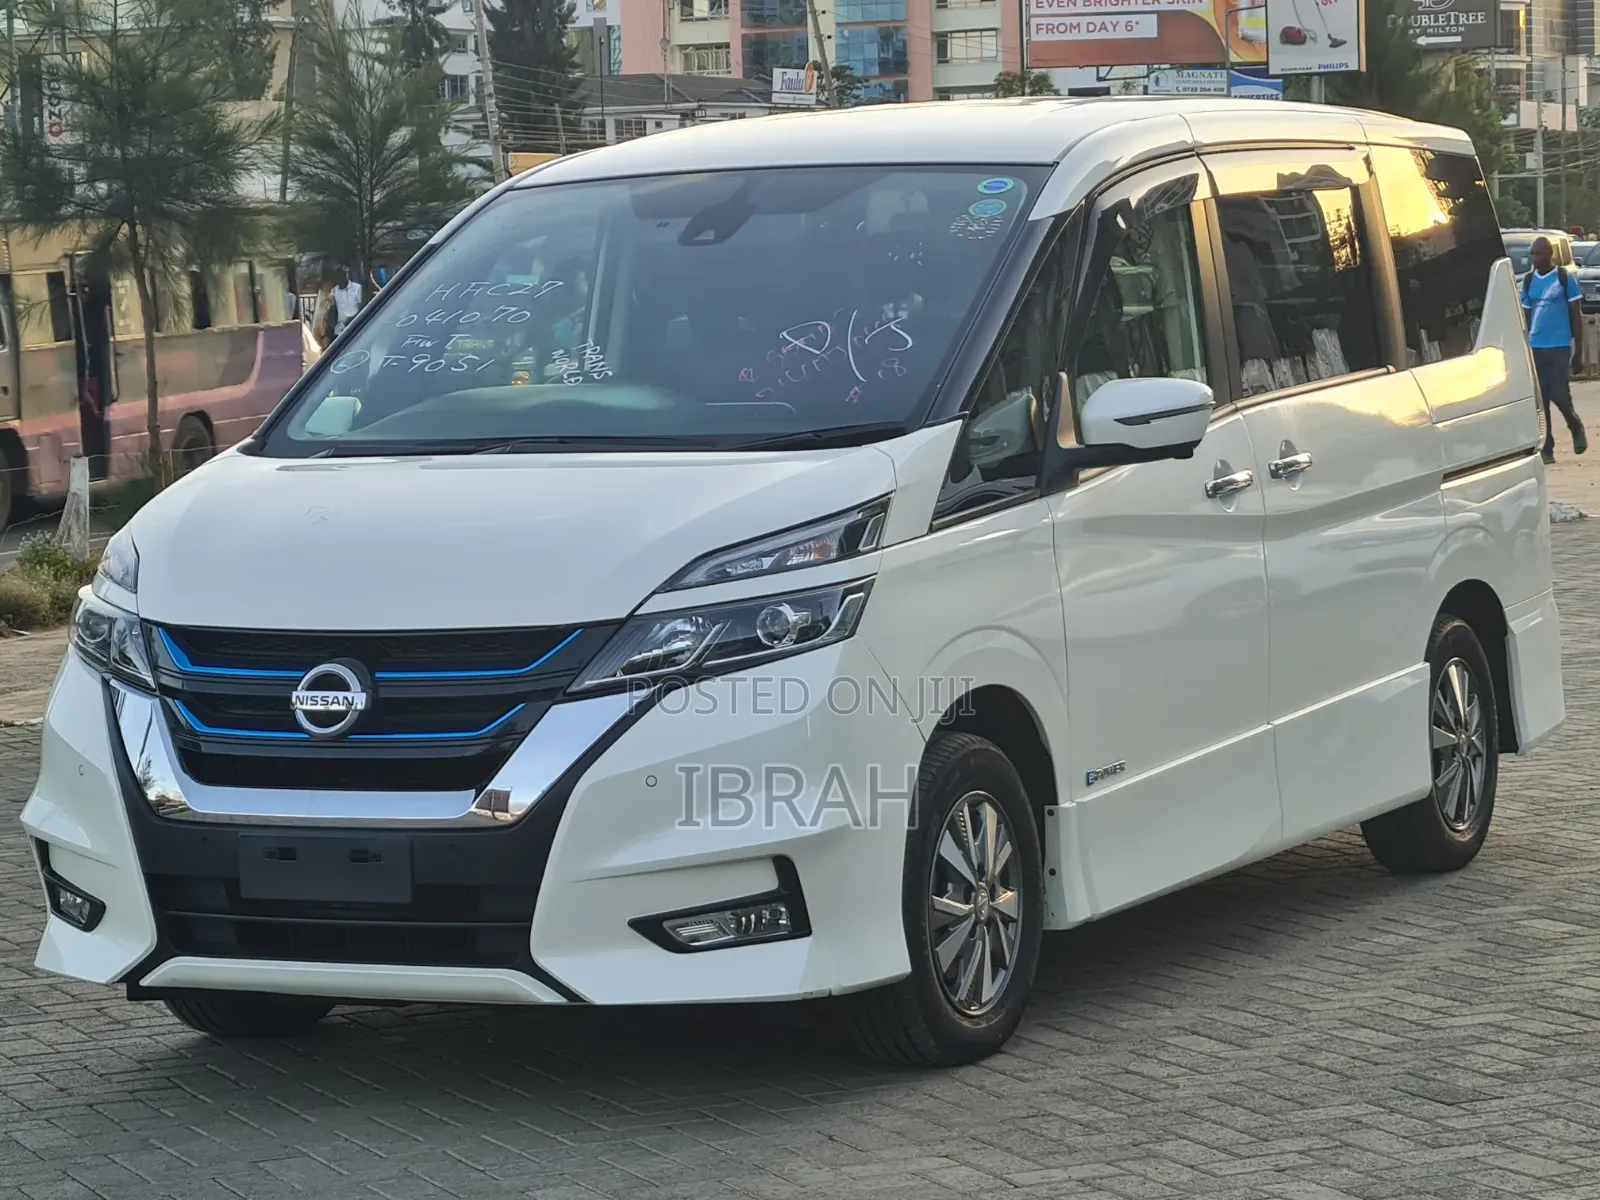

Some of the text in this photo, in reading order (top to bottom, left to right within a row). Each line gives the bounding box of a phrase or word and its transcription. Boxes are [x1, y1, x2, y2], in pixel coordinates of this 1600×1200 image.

[1036, 22, 1081, 35] FROM
[1086, 21, 1119, 33] DAY
[1317, 62, 1349, 70] PHILIPS
[1175, 71, 1226, 79] MAGNATE
[294, 695, 355, 706] NISSAN
